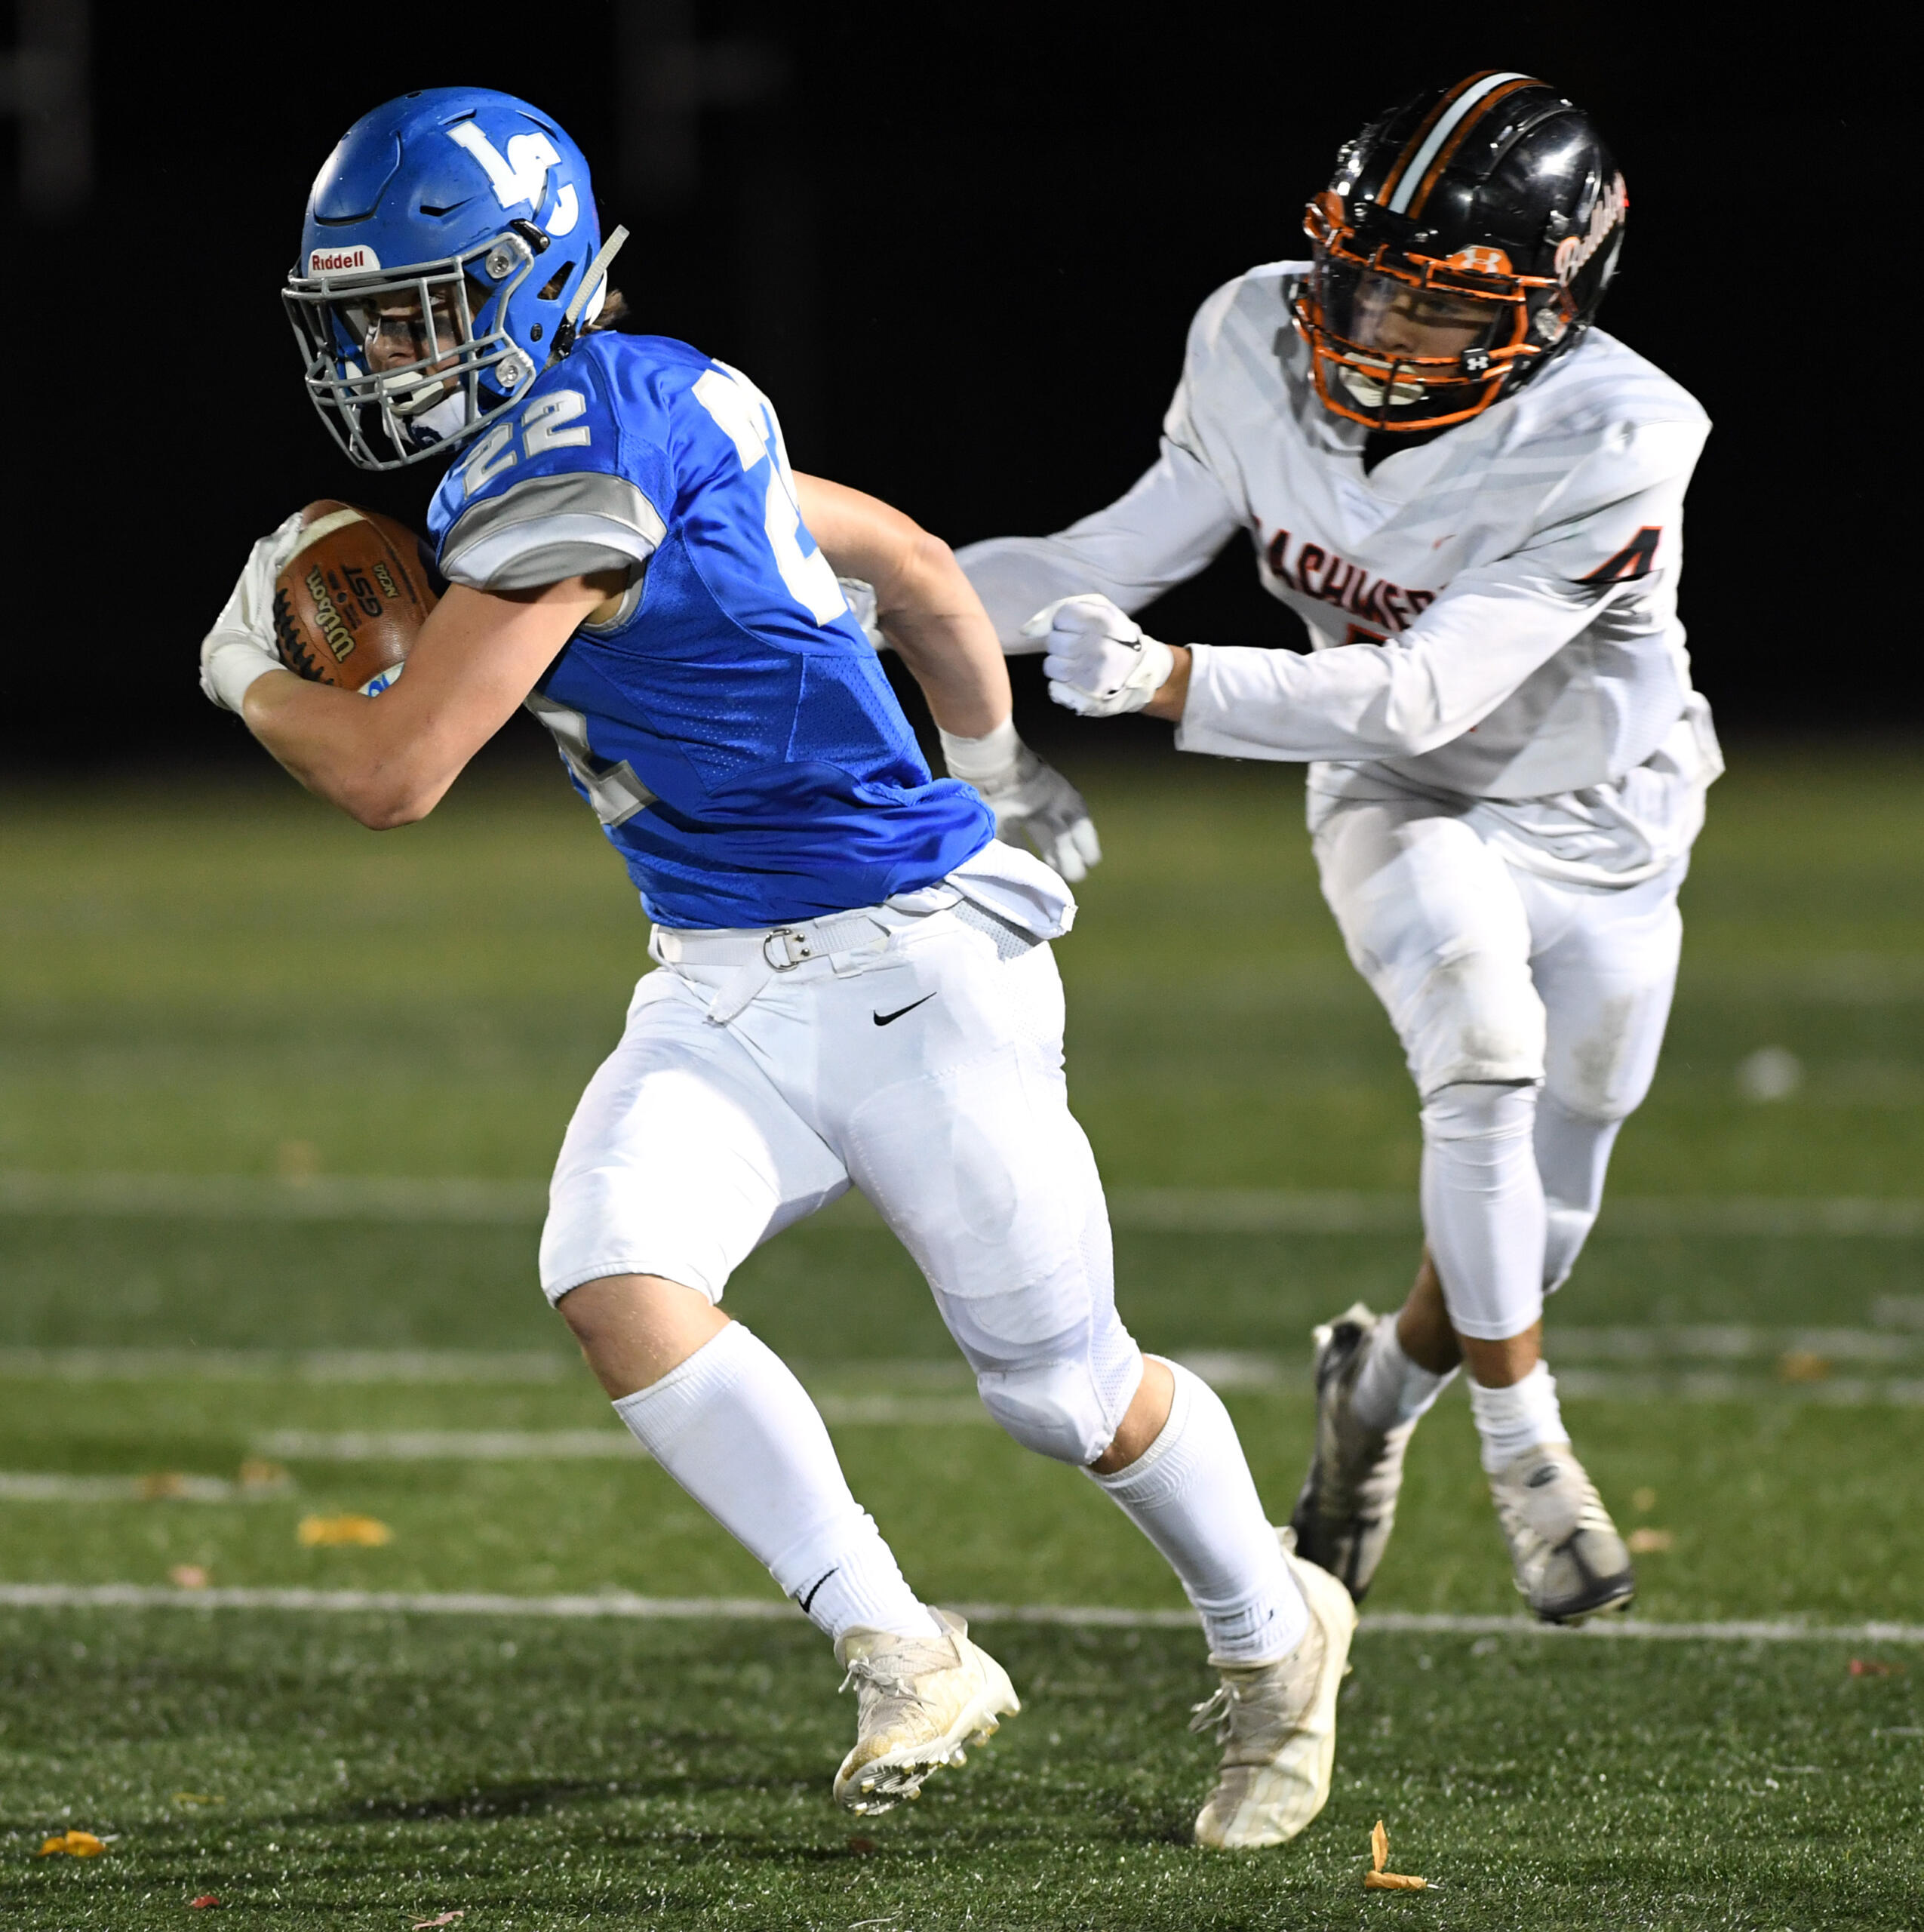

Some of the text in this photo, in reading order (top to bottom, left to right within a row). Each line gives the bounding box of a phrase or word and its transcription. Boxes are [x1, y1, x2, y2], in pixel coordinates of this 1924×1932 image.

[312, 250, 364, 271] Riddell
[462, 389, 591, 501] 22
[342, 564, 383, 618] GST
[373, 561, 400, 599] NCAA
[304, 563, 357, 665] Wilson
